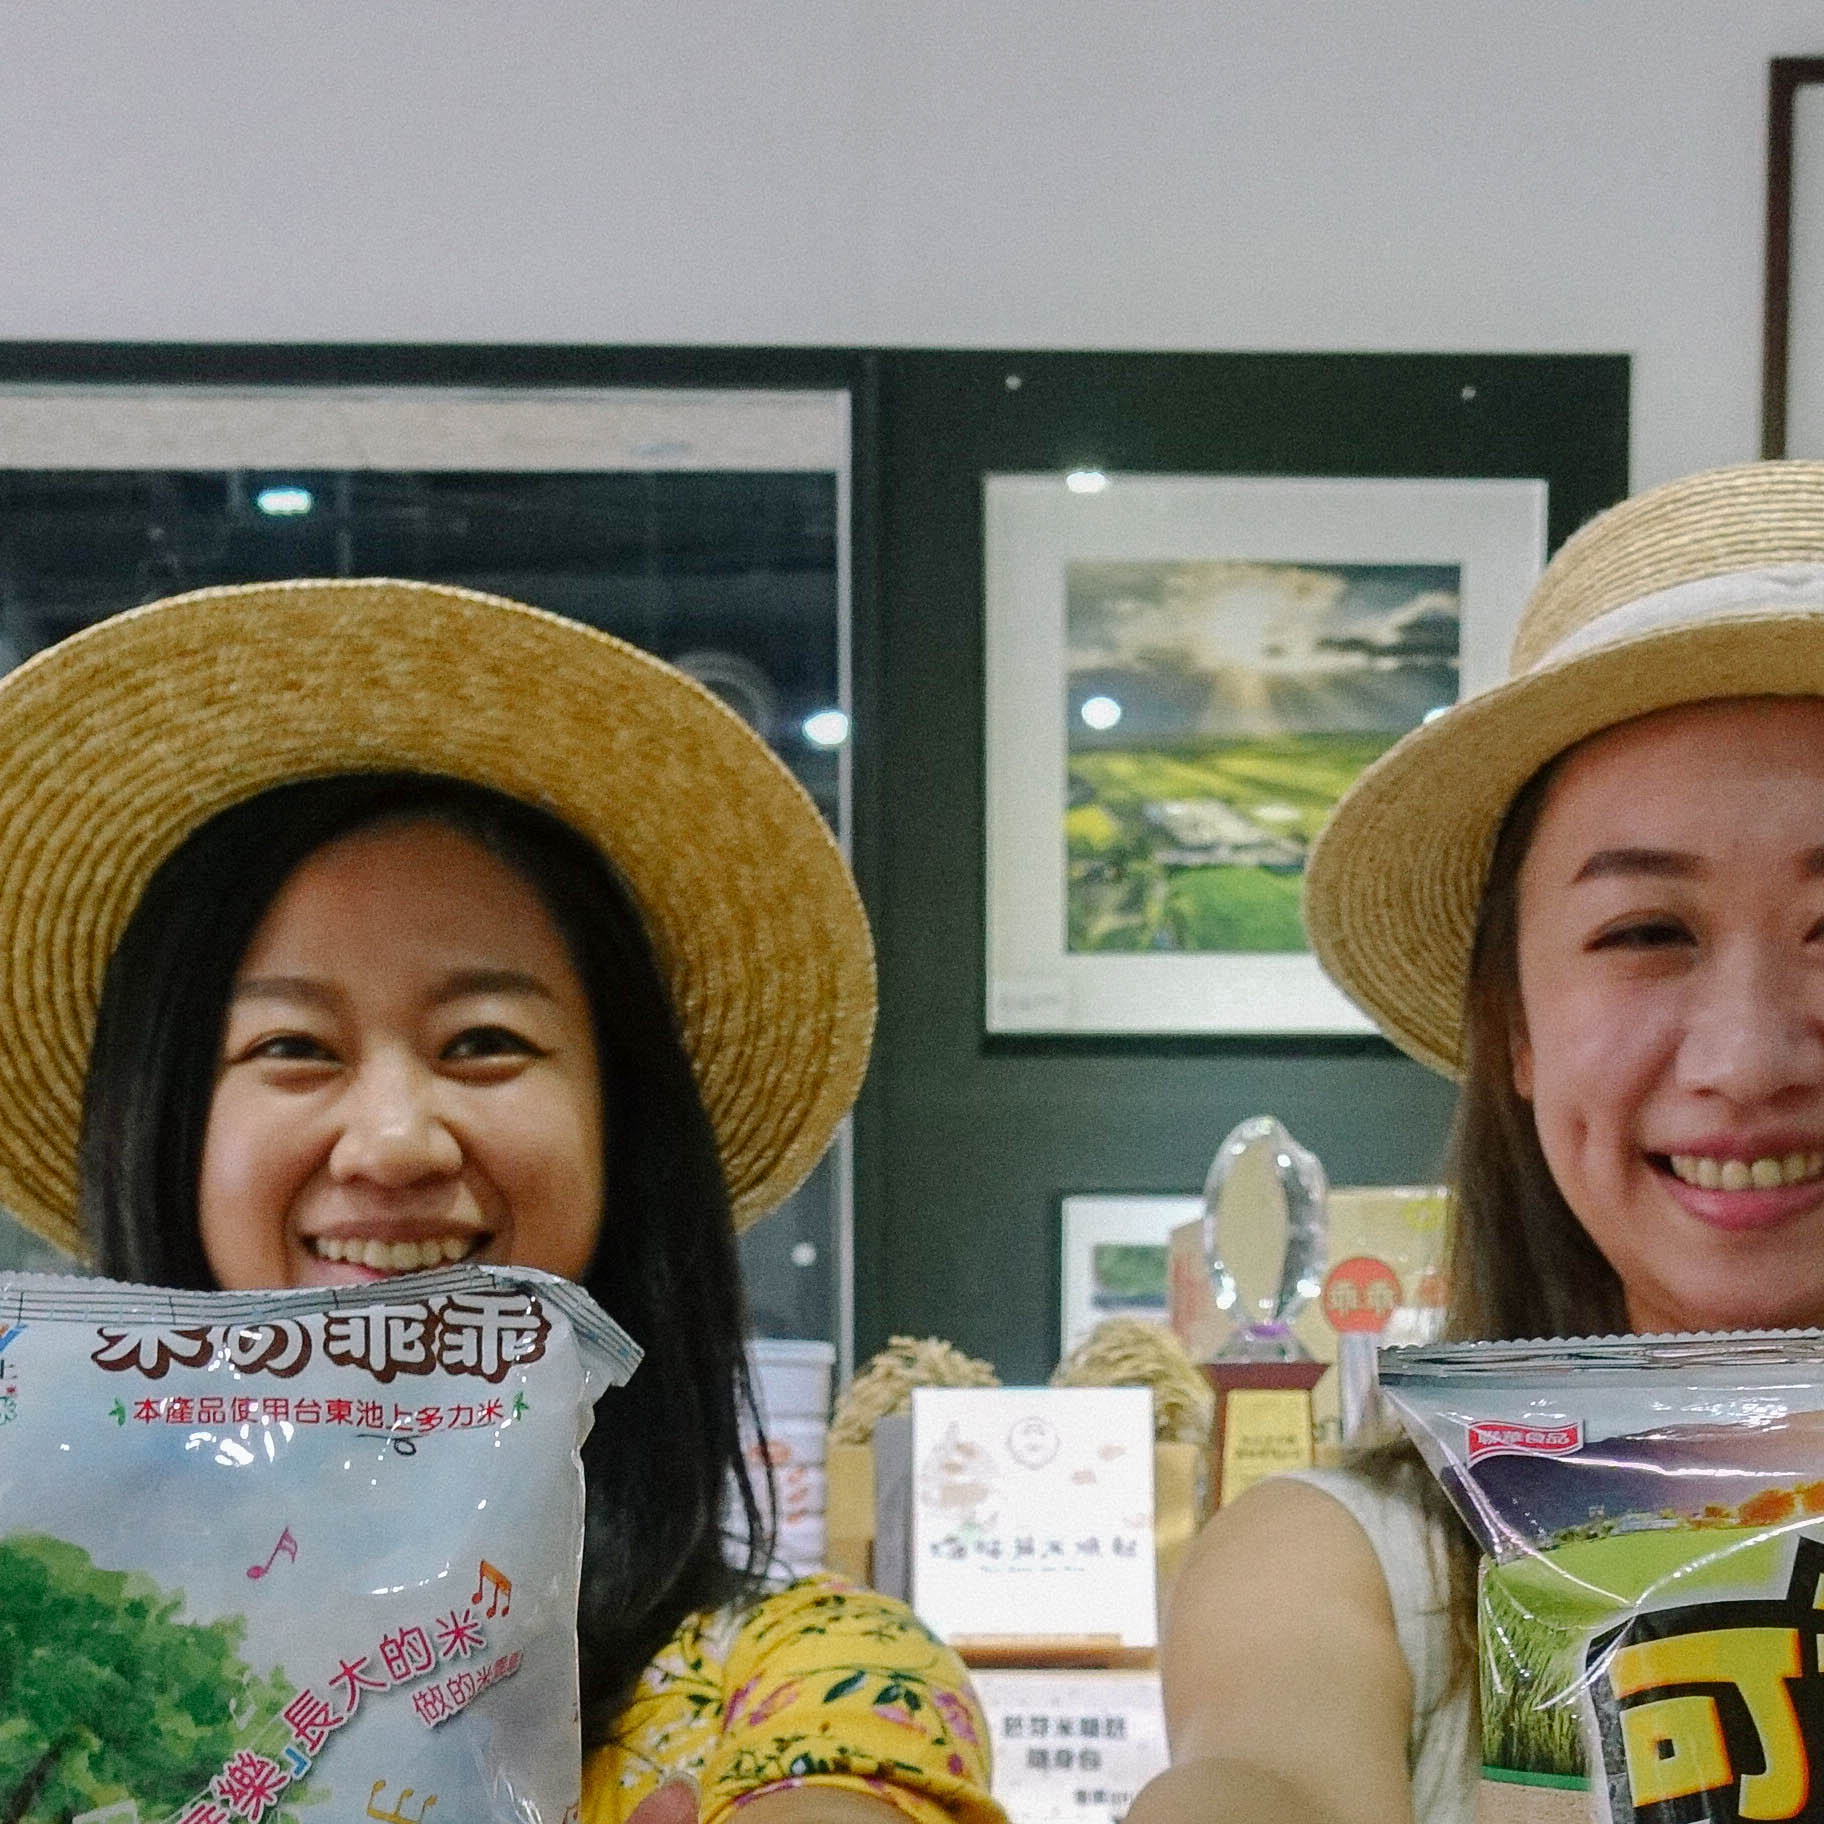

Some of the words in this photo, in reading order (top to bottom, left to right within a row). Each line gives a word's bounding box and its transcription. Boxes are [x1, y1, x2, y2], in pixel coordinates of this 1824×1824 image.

[133, 1395, 505, 1435] 本產品使用台東池上多力米
